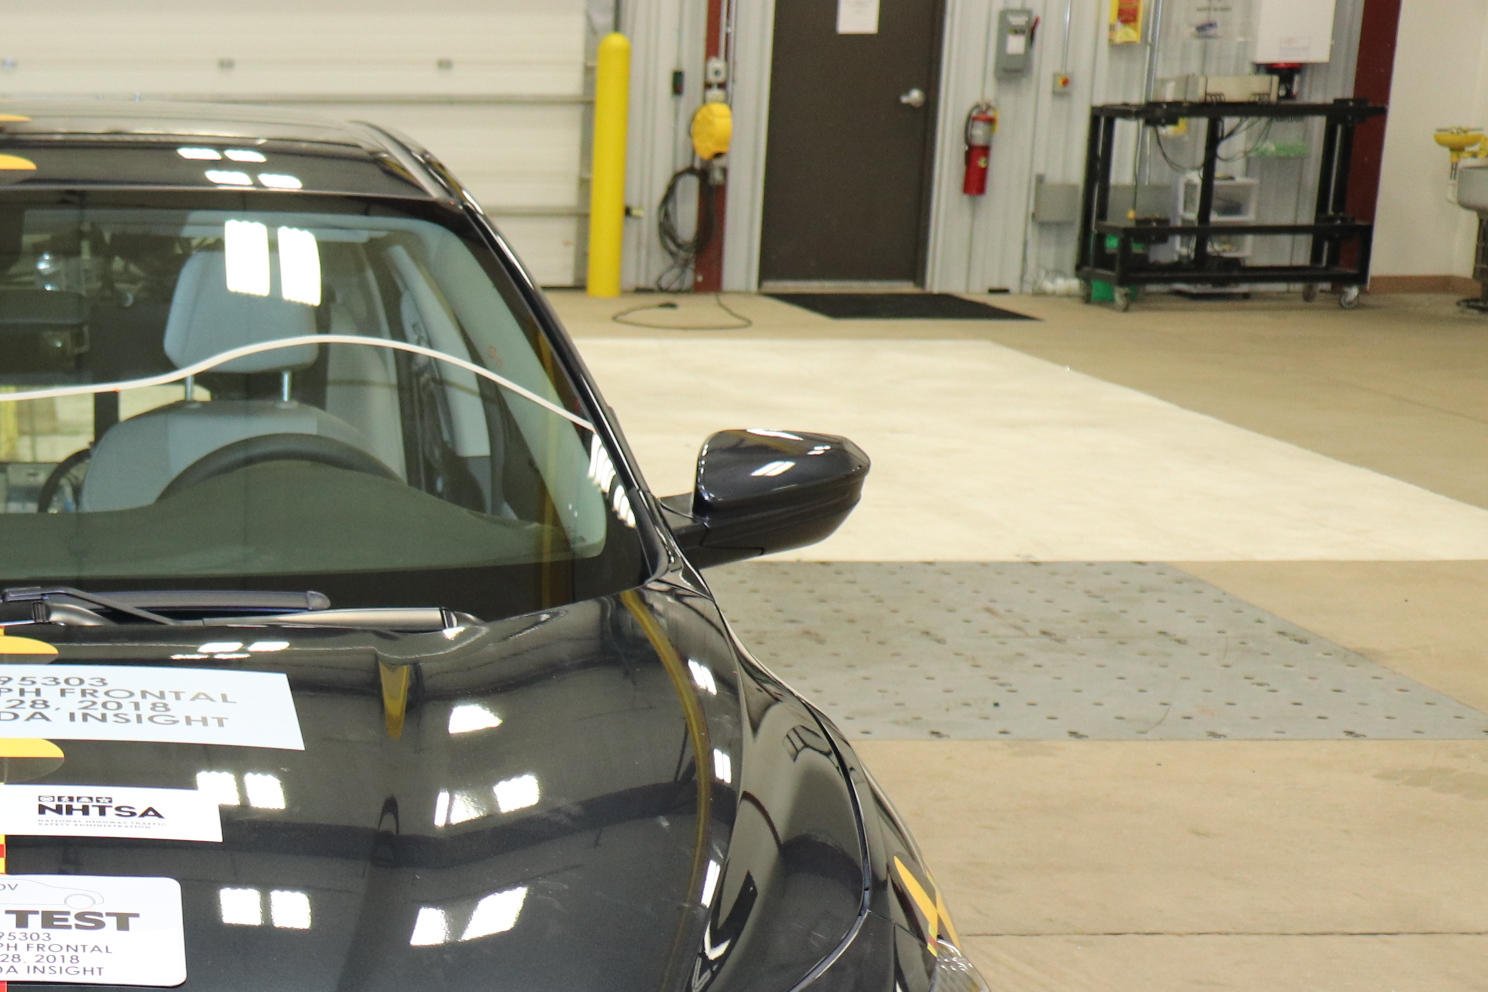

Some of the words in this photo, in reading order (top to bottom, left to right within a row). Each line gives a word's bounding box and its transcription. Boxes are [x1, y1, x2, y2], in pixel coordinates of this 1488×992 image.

[59, 687, 238, 704] FRONTAL
[5, 699, 61, 711] 28,
[77, 701, 172, 713] 2018
[68, 711, 230, 728] INSIGHT
[38, 803, 166, 820] NHTSA
[5, 909, 140, 931] TEST
[26, 943, 113, 954] FRONTAL
[0, 954, 27, 964] 28,
[34, 954, 80, 964] 2018
[26, 965, 104, 977] INSIGHT
